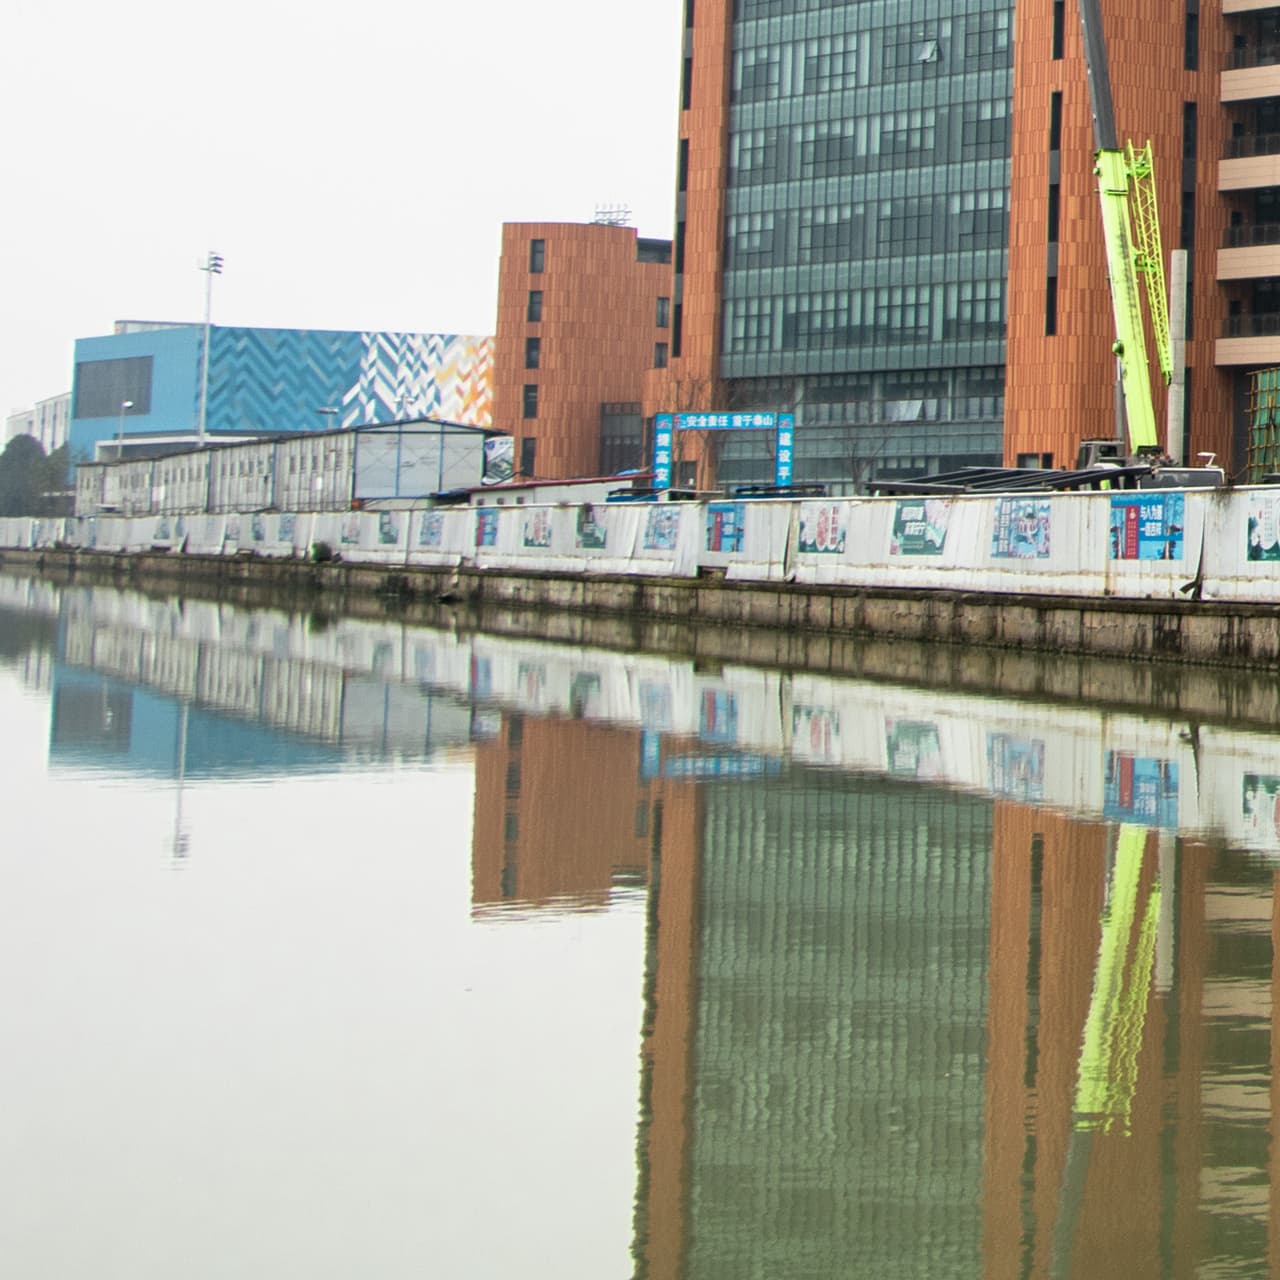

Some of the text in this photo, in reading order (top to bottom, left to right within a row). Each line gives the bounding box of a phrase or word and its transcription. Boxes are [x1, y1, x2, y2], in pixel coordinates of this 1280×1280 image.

[655, 432, 670, 489] 提高安
[777, 432, 792, 486] 建设平
